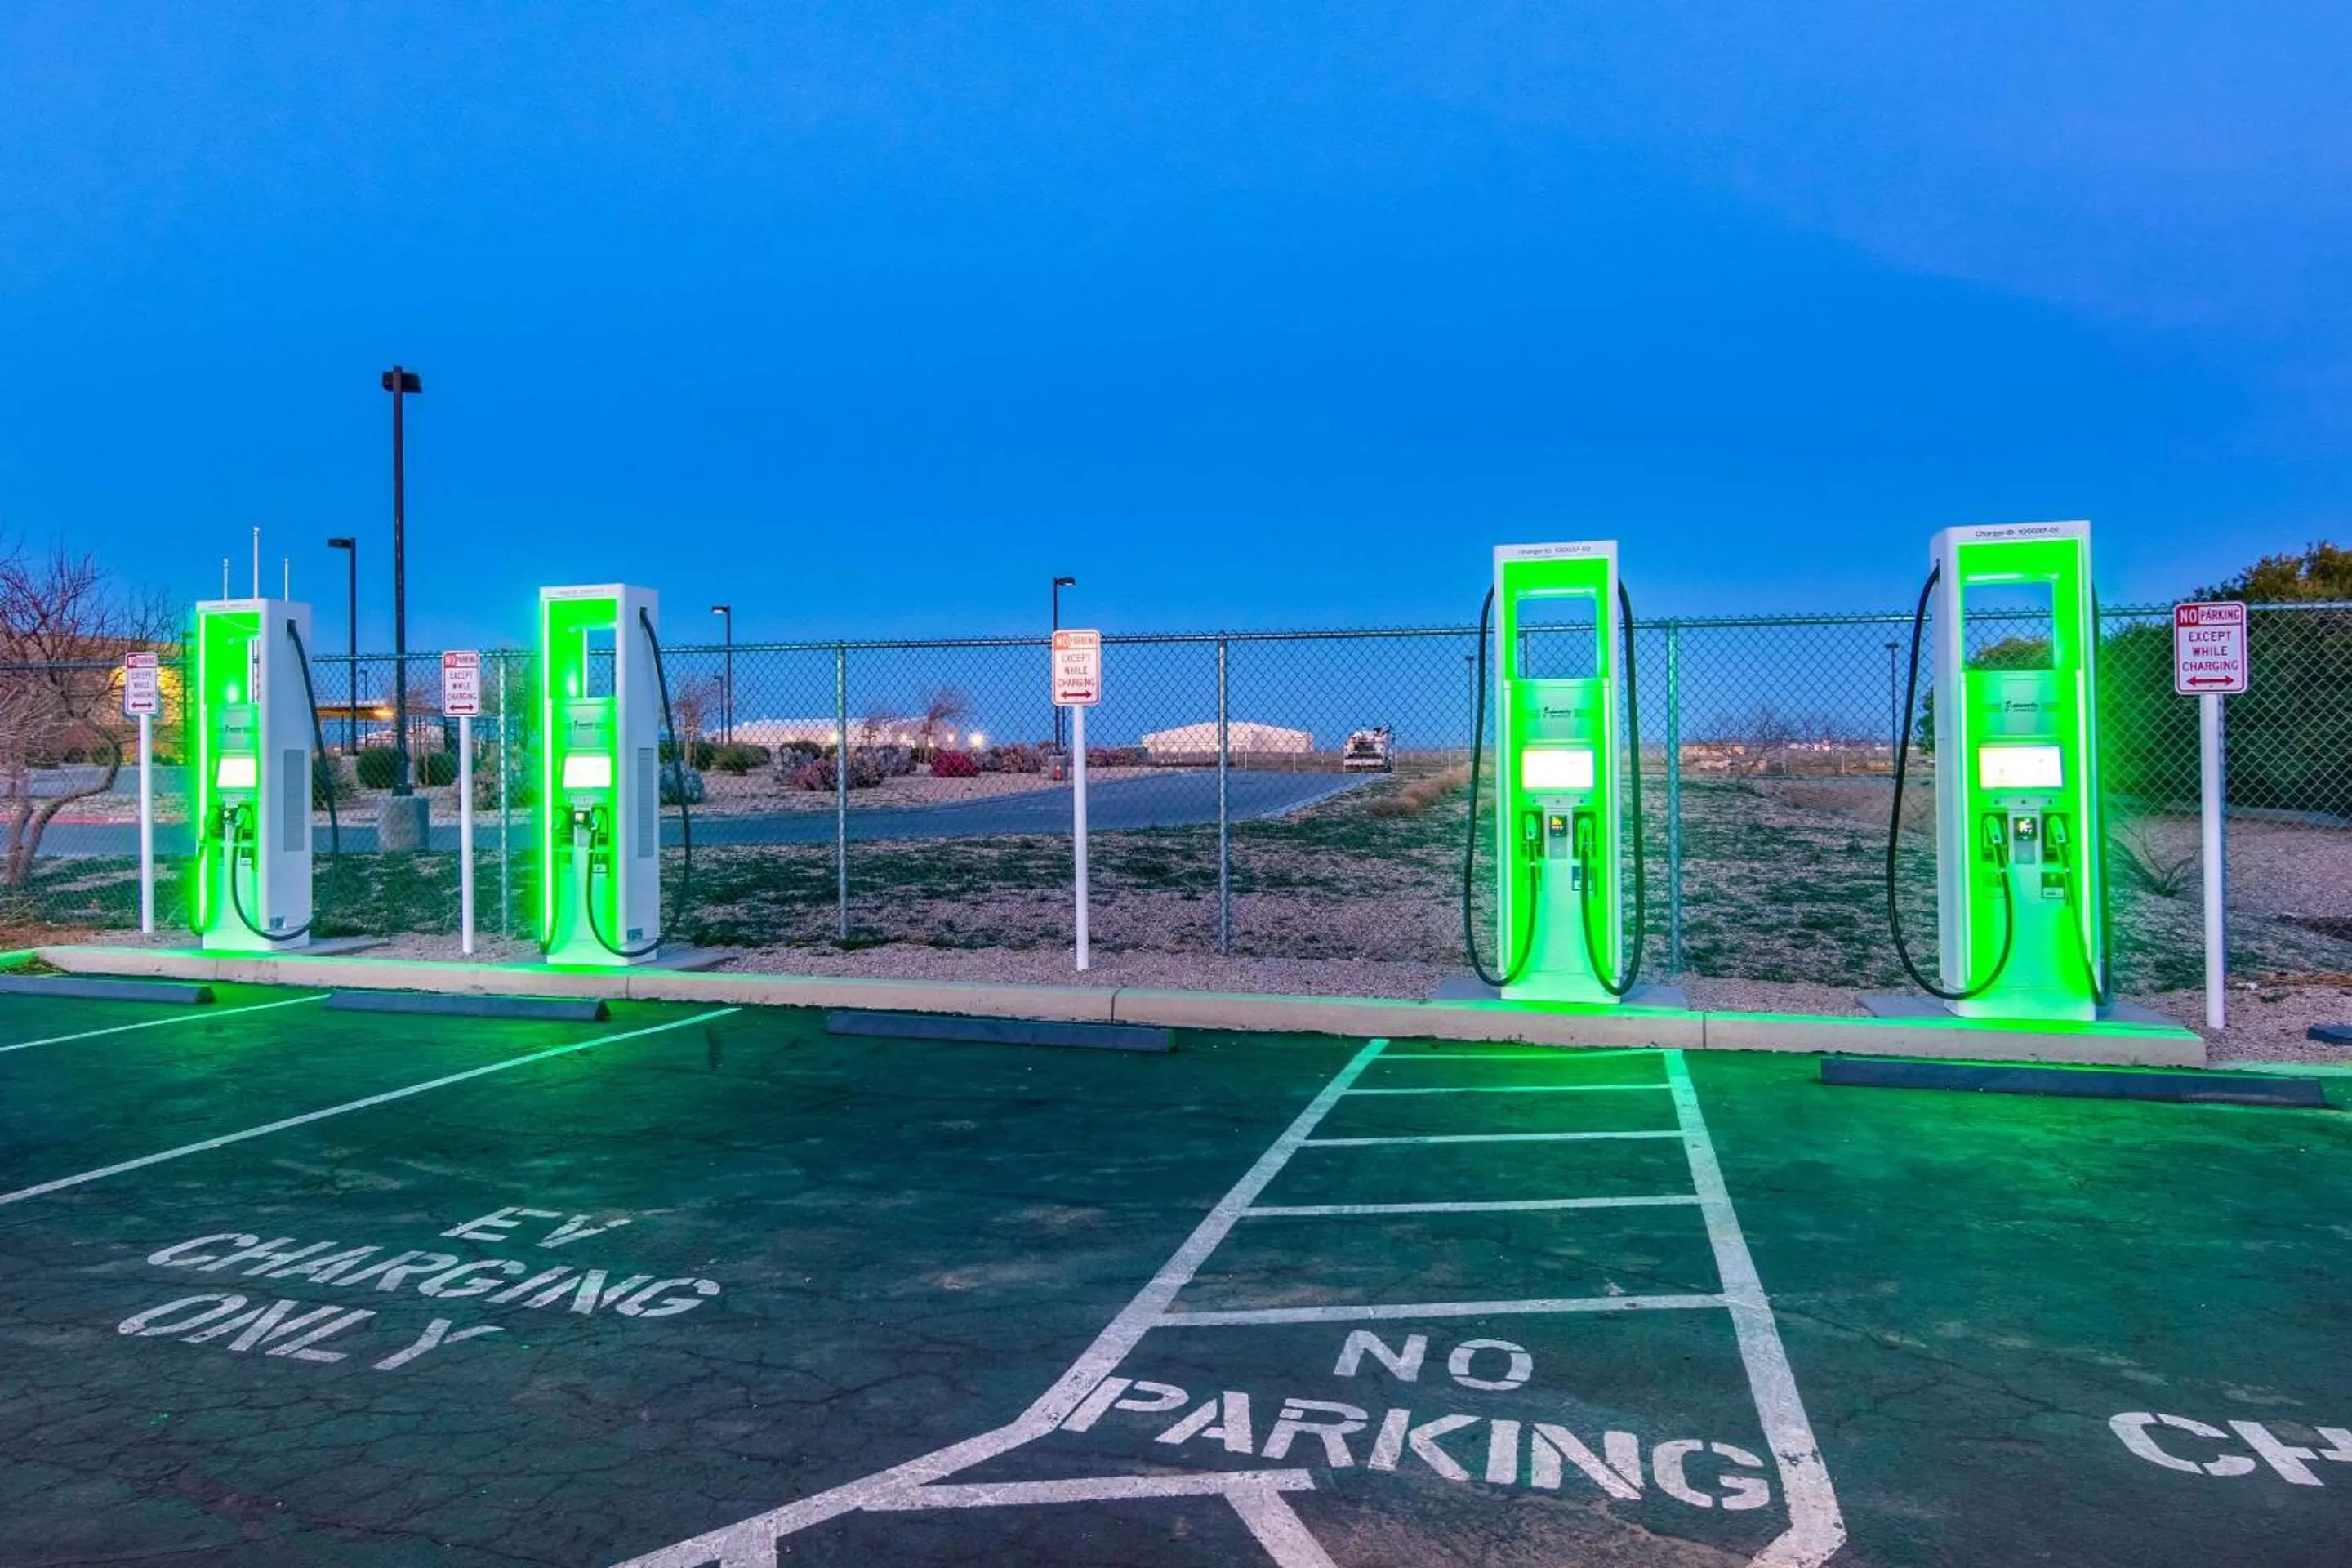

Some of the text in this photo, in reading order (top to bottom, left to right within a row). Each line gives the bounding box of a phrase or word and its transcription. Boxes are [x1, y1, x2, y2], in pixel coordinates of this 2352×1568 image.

[2180, 608, 2240, 624] NO PARKING
[2188, 631, 2232, 642] EXCEPT
[2182, 660, 2238, 672] CHARGING
[2192, 645, 2228, 657] WHILE
[439, 1206, 633, 1249] EV
[147, 1232, 721, 1317] CHARGING
[117, 1294, 505, 1370] ONLY
[1334, 1329, 1533, 1392] NO
[1060, 1376, 1772, 1511] PARKING
